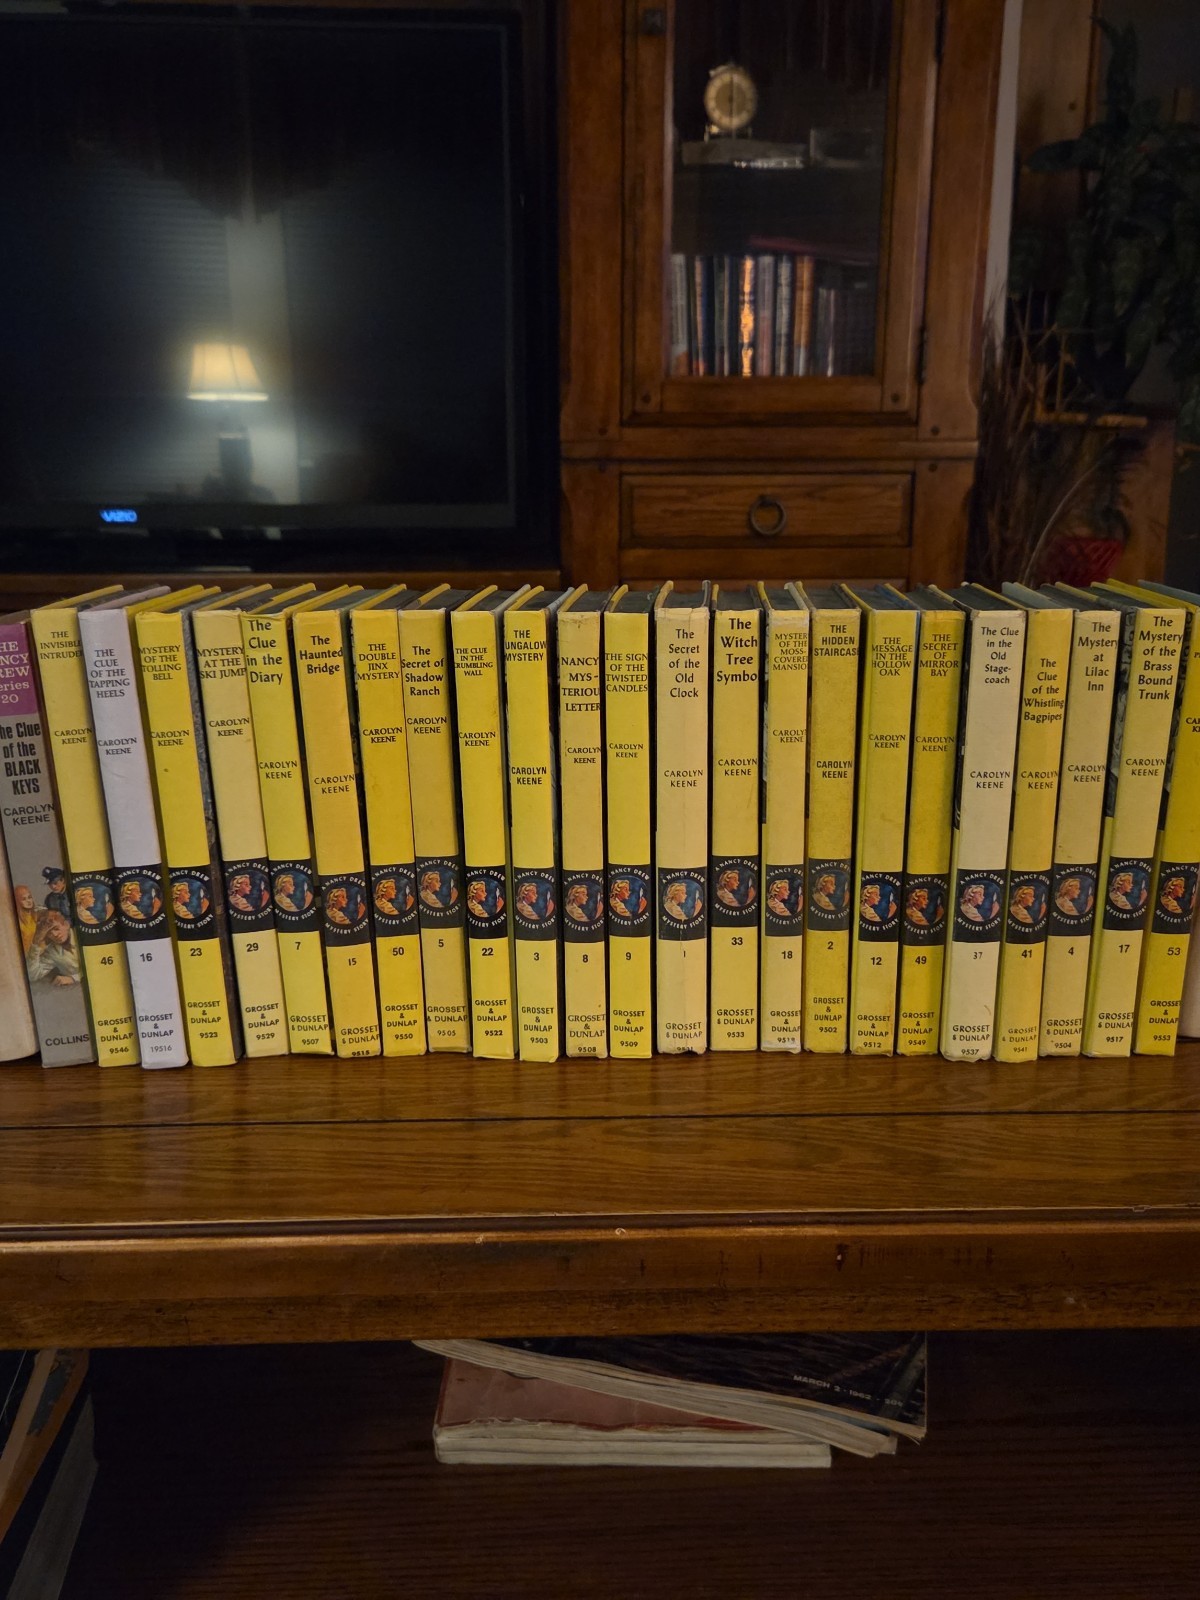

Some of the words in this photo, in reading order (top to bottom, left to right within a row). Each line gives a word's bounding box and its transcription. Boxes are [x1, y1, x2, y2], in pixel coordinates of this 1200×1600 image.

[248, 619, 272, 632] The
[728, 618, 752, 630] The
[1154, 616, 1173, 626] The
[830, 625, 847, 634] THE
[981, 626, 997, 636] The
[1000, 627, 1020, 636] Clue
[1092, 622, 1111, 632] The
[514, 630, 530, 638] THE
[676, 628, 694, 639] The
[1139, 630, 1183, 644] Mystery
[248, 636, 276, 649] Clue
[310, 635, 330, 646] The
[506, 641, 546, 650] UNGALOW
[720, 636, 758, 648] Witch
[822, 636, 854, 645] HIDDEN
[986, 640, 994, 648] in
[998, 640, 1012, 648] the
[95, 649, 115, 657] THE
[140, 644, 181, 654] MYSTERY
[197, 646, 244, 657] MYSTERY
[300, 646, 343, 660] Haunted
[412, 646, 430, 656] The
[668, 644, 700, 654] Secret
[872, 644, 913, 652] MESSAGE
[1143, 646, 1156, 656] of
[1160, 646, 1176, 656] the
[144, 656, 156, 664] OF
[158, 654, 178, 662] THE
[246, 656, 258, 666] in
[262, 654, 282, 665] the
[358, 652, 396, 662] DOUBLE
[506, 652, 544, 662] MYSTERY
[605, 653, 622, 661] THE
[626, 653, 648, 662] SIGN
[726, 654, 754, 665] Tree
[990, 652, 1006, 660] Old
[1093, 654, 1104, 662] at
[94, 659, 118, 668] CLUE
[142, 664, 182, 672] TOLLING
[204, 660, 218, 668] AT
[220, 658, 241, 666] THE
[368, 662, 388, 671] JINX
[401, 658, 430, 668] Secret
[434, 658, 444, 668] of
[610, 664, 622, 672] OF
[668, 658, 680, 668] of
[684, 658, 700, 668] the
[872, 660, 911, 668] HOLLOW
[920, 660, 958, 668] MIRROR
[1040, 658, 1056, 668] The
[1144, 660, 1172, 671] Brass
[90, 670, 103, 678] OF
[106, 668, 126, 677] THE
[200, 670, 216, 679] SKI
[220, 668, 246, 679] JUMP
[306, 663, 340, 676] Bridge
[880, 668, 900, 676] OAK
[984, 664, 1012, 674] Stage-
[1086, 666, 1110, 677] Lilac
[153, 672, 173, 680] BELL
[250, 671, 283, 686] Diary
[358, 672, 400, 680] MYSTERY
[405, 672, 444, 682] Shadow
[606, 674, 648, 682] TWISTED
[675, 672, 694, 683] Old
[716, 670, 758, 686] Symbo
[1037, 672, 1058, 680] Clue
[1138, 675, 1173, 686] Bound
[89, 678, 130, 688] TAPPING
[606, 684, 648, 692] CANDLES
[1088, 681, 1104, 692] Inn
[96, 689, 125, 698] HEELS
[410, 686, 440, 696] Ranch
[670, 688, 698, 698] Clock
[1032, 686, 1042, 694] of
[1046, 685, 1060, 694] the
[1139, 689, 1170, 700] Trunk
[1, 694, 18, 704] 20
[1024, 698, 1064, 709] Whistling
[407, 716, 447, 725] CAROLYN
[1024, 712, 1062, 723] Bagpipes
[16, 722, 41, 738] Clue
[3, 743, 14, 758] of
[17, 742, 36, 757] the
[4, 759, 42, 777] BLACK
[664, 770, 704, 778] CAROLYN
[970, 771, 1010, 780] CAROLYN
[12, 778, 40, 795] KEYS
[670, 780, 698, 788] KEENE
[294, 942, 302, 950] 7
[438, 938, 444, 948] 5
[732, 936, 744, 946] 33
[827, 941, 834, 950] 2
[246, 942, 259, 952] 29
[392, 947, 404, 956] 50
[482, 948, 494, 956] 22
[1068, 947, 1074, 956] 4
[1118, 944, 1130, 953] 17
[1168, 947, 1181, 956] 53
[140, 953, 152, 962] 16
[190, 948, 202, 957] 23
[534, 952, 540, 961] 3
[626, 952, 632, 960] 9
[781, 950, 792, 959] 18
[1022, 950, 1032, 958] 41
[100, 956, 114, 966] 46
[348, 958, 357, 966] 15
[582, 954, 588, 963] 8
[870, 957, 882, 966] 12
[915, 956, 927, 965] 49
[45, 1034, 90, 1047] COLLINS
[793, 1375, 830, 1388] MARCH
